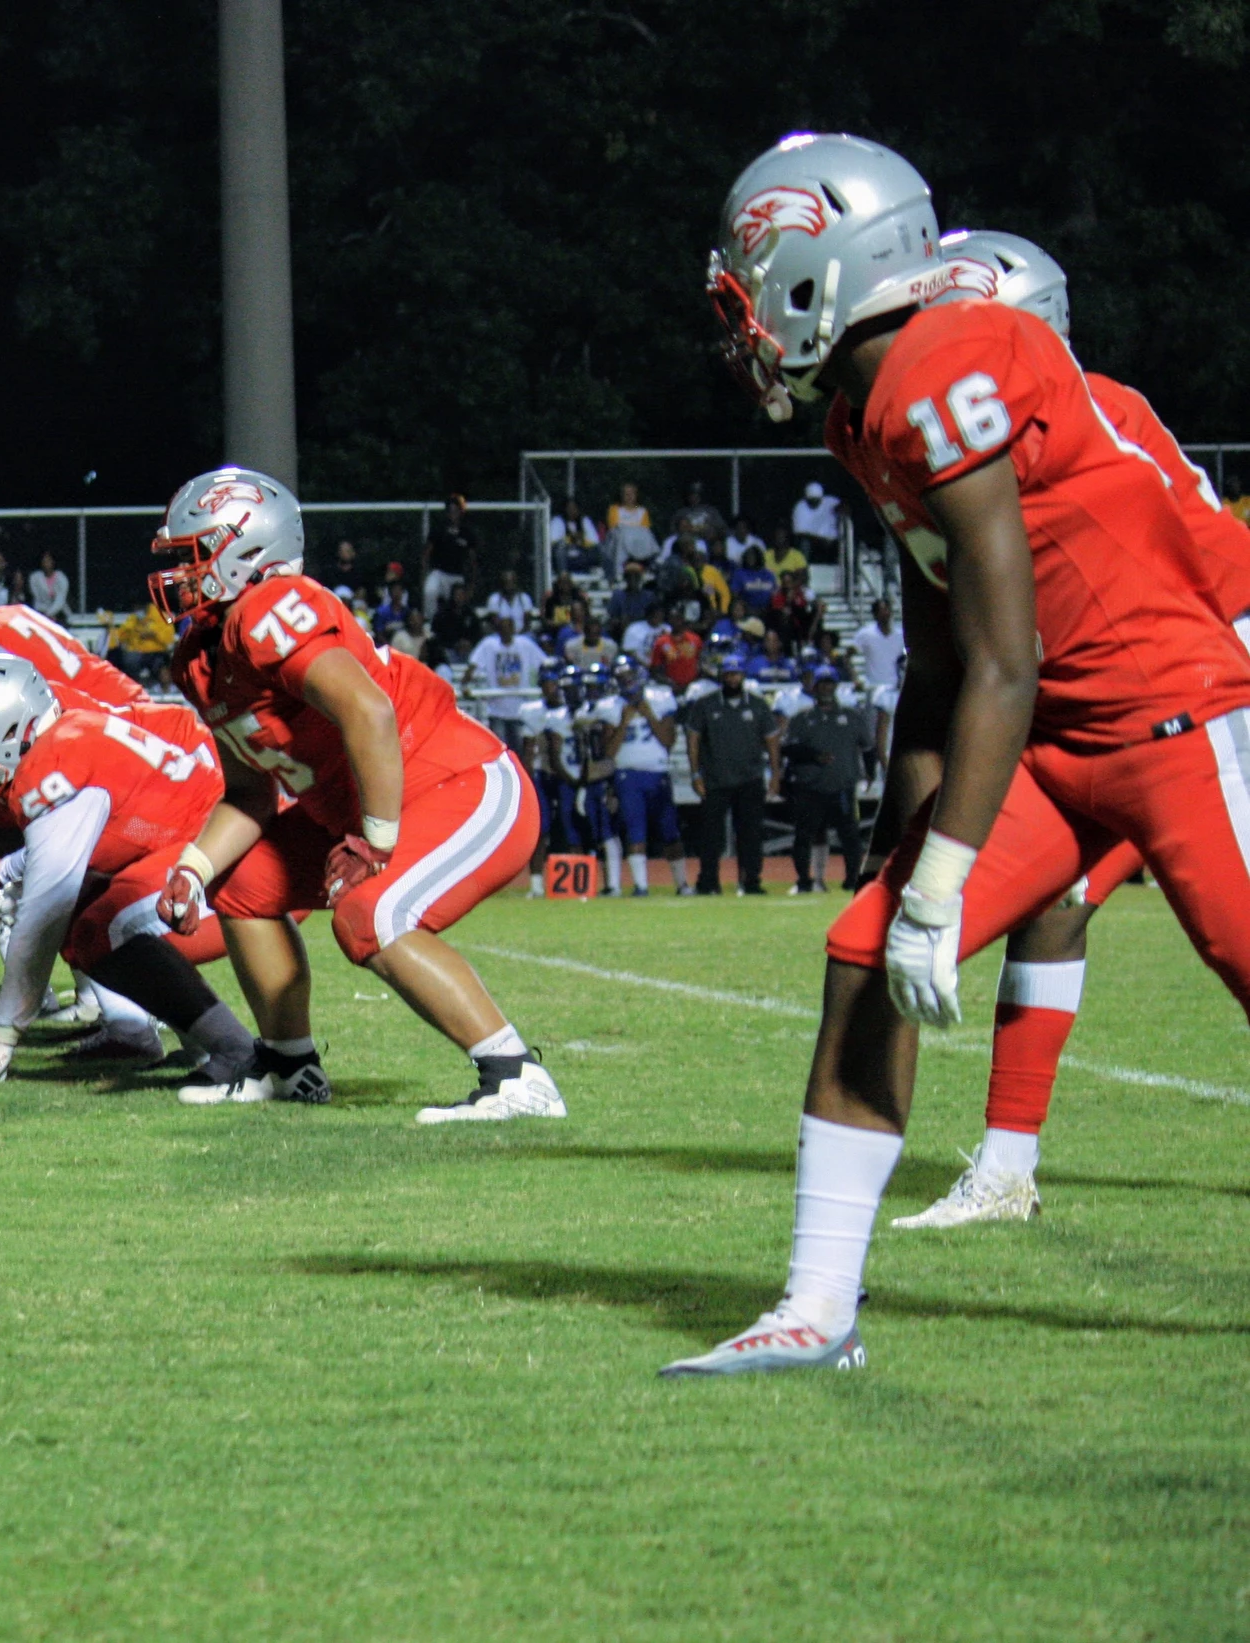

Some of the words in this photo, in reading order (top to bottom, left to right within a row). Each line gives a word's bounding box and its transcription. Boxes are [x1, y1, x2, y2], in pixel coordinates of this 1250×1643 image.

[906, 371, 1012, 474] 16
[250, 588, 318, 658] 75
[20, 771, 79, 819] 59
[553, 861, 590, 894] 20
